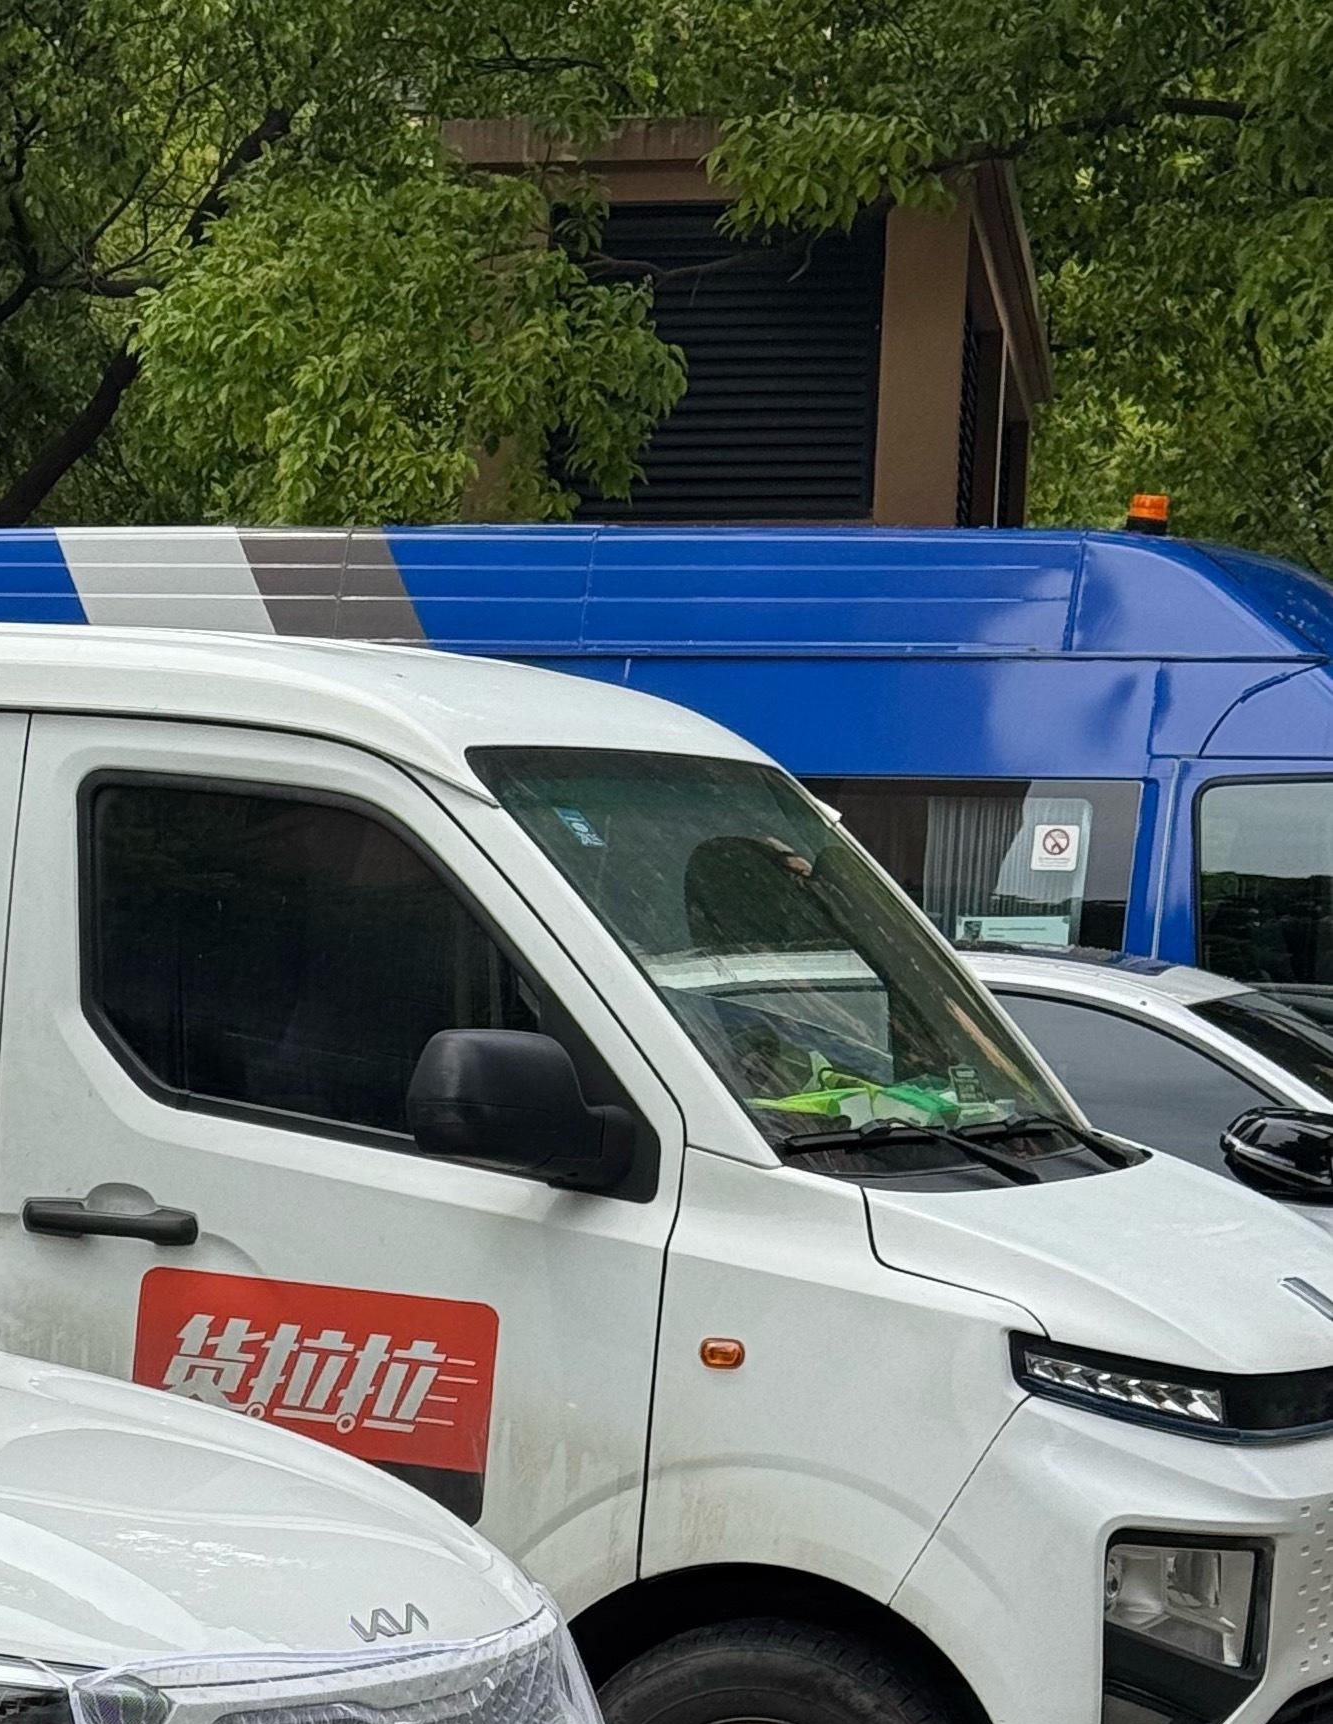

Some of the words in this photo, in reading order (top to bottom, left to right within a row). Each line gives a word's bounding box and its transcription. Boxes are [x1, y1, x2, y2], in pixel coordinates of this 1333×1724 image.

[162, 1313, 447, 1434] 货拉拉
[349, 1602, 430, 1643] KIA
